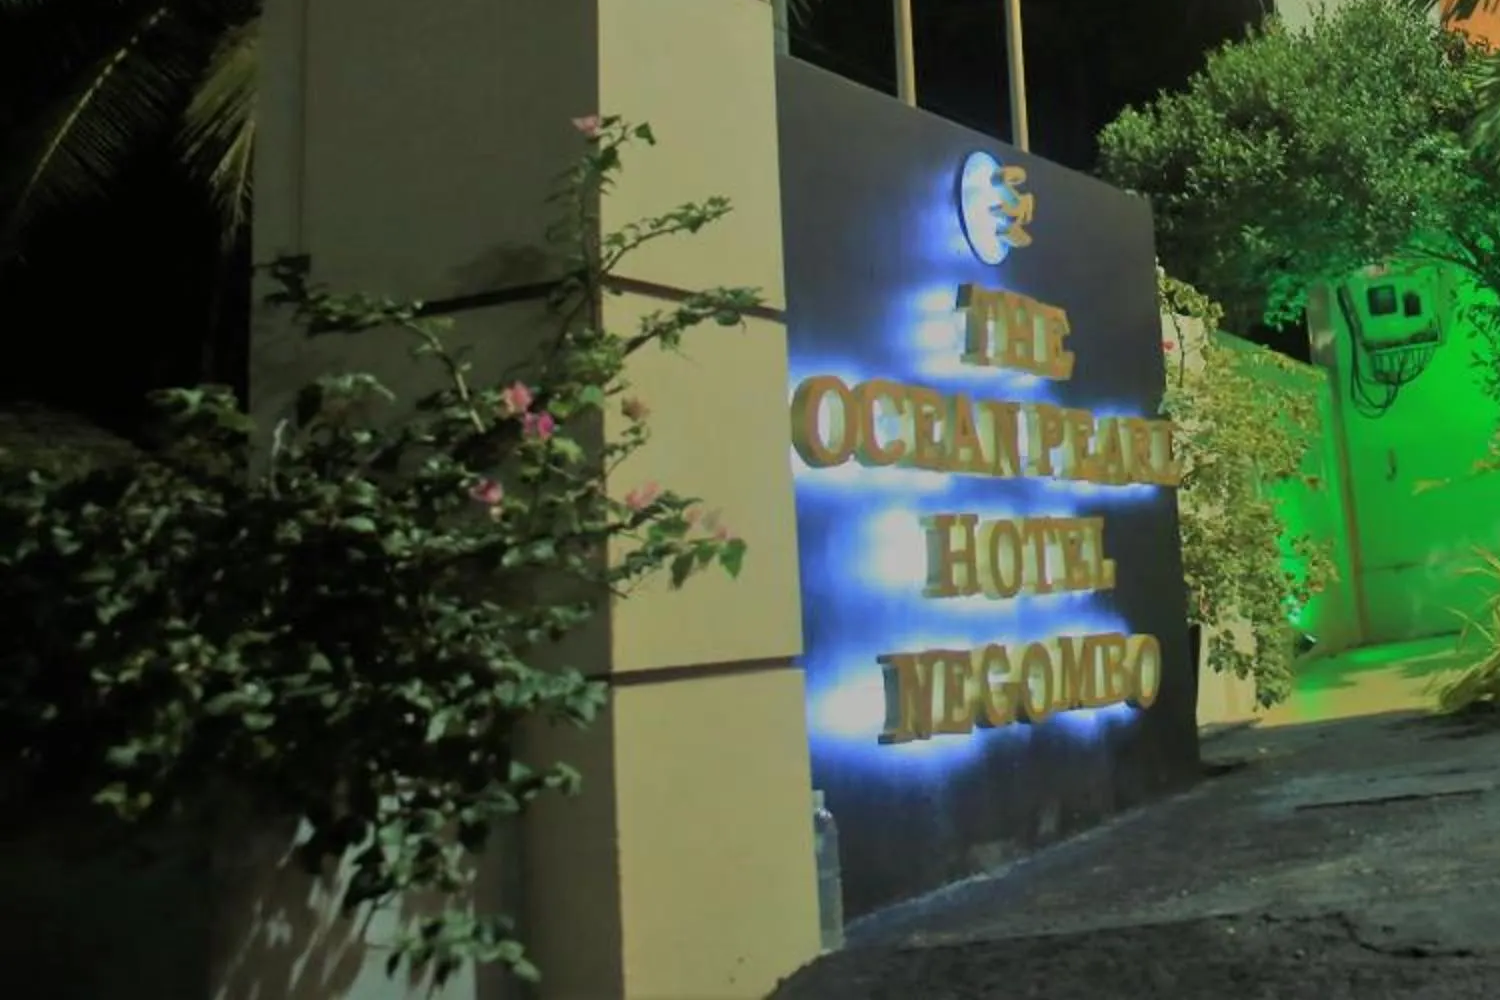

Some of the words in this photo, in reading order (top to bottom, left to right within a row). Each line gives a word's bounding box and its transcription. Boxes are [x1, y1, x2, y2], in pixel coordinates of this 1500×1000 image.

[957, 283, 1075, 380] THE
[790, 376, 1022, 478] OCEAN
[1024, 402, 1184, 487] PEARL
[922, 513, 1116, 600] HOTEL
[877, 633, 1162, 744] NEGOMBO
